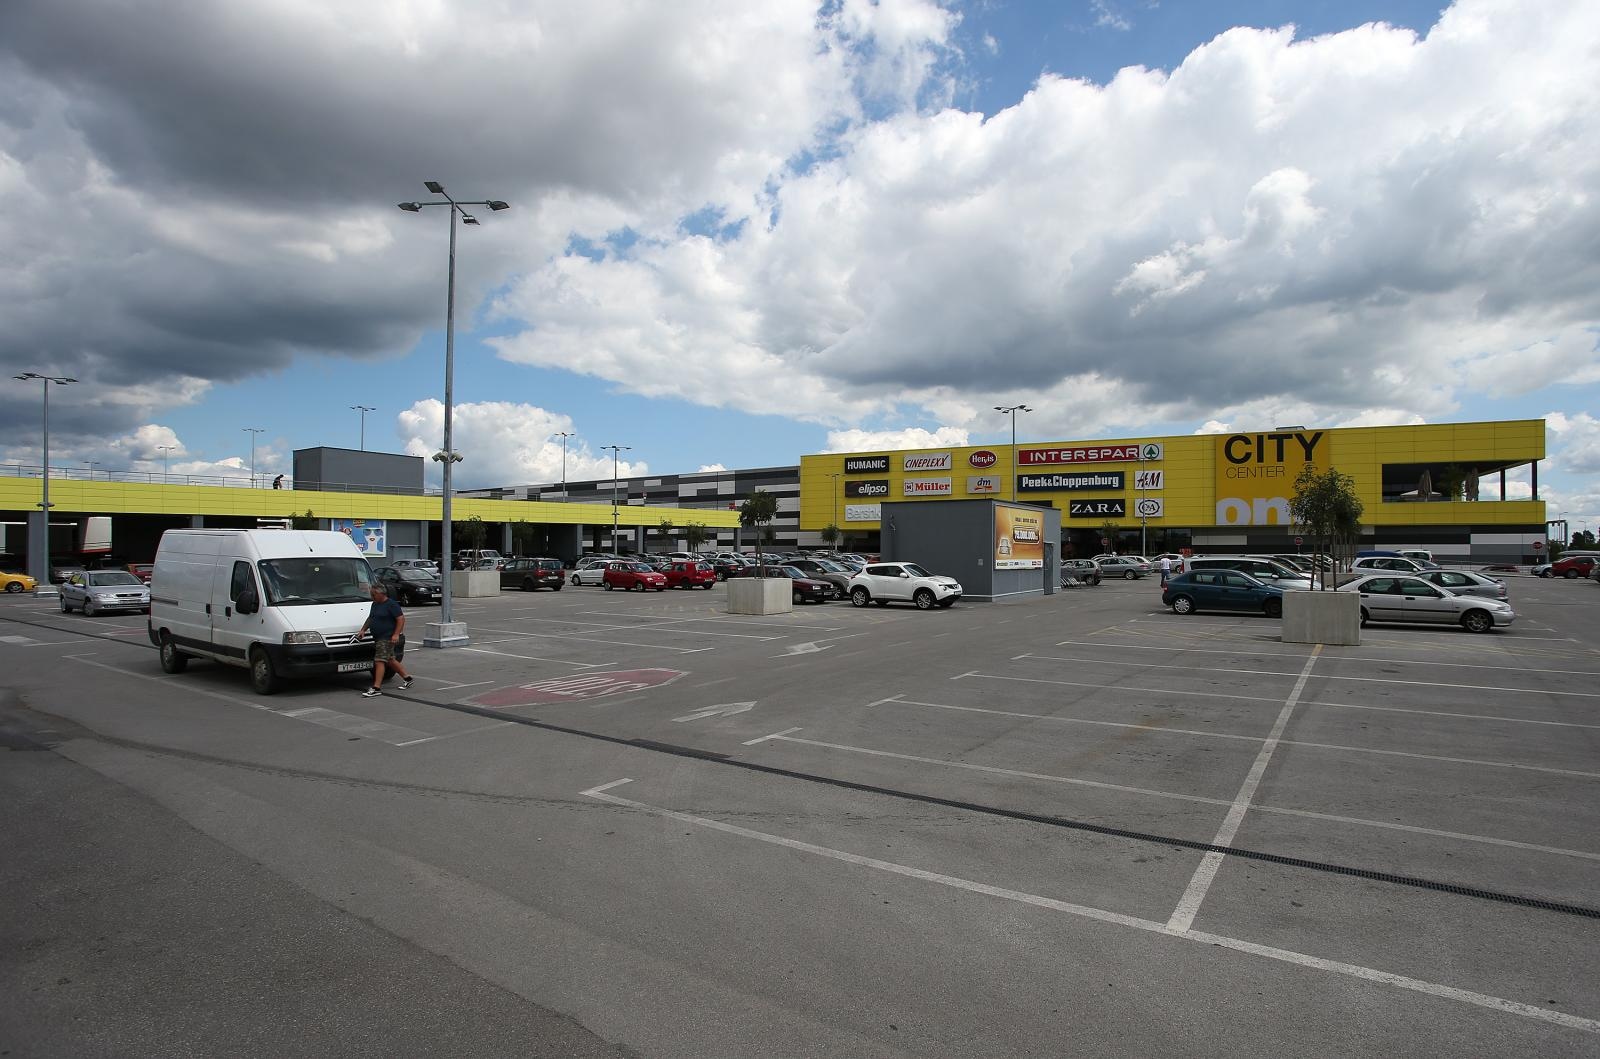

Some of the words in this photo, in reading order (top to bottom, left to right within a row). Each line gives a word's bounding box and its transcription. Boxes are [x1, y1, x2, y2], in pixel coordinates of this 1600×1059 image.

[1224, 432, 1324, 464] CITY
[972, 454, 994, 464] Hervis
[1030, 447, 1138, 462] INTERSPAR
[847, 459, 886, 470] HUMANIC
[905, 455, 949, 469] CINEPLEXX
[1226, 466, 1285, 479] CENTER
[977, 477, 991, 486] dm
[1022, 475, 1119, 487] Peek&Cloppenburg
[1137, 472, 1161, 488] H&M
[858, 482, 887, 495] elipso
[915, 482, 950, 491] Müller
[847, 507, 881, 519] Bershk
[1071, 503, 1124, 513] ZARA
[1216, 497, 1312, 525] on
